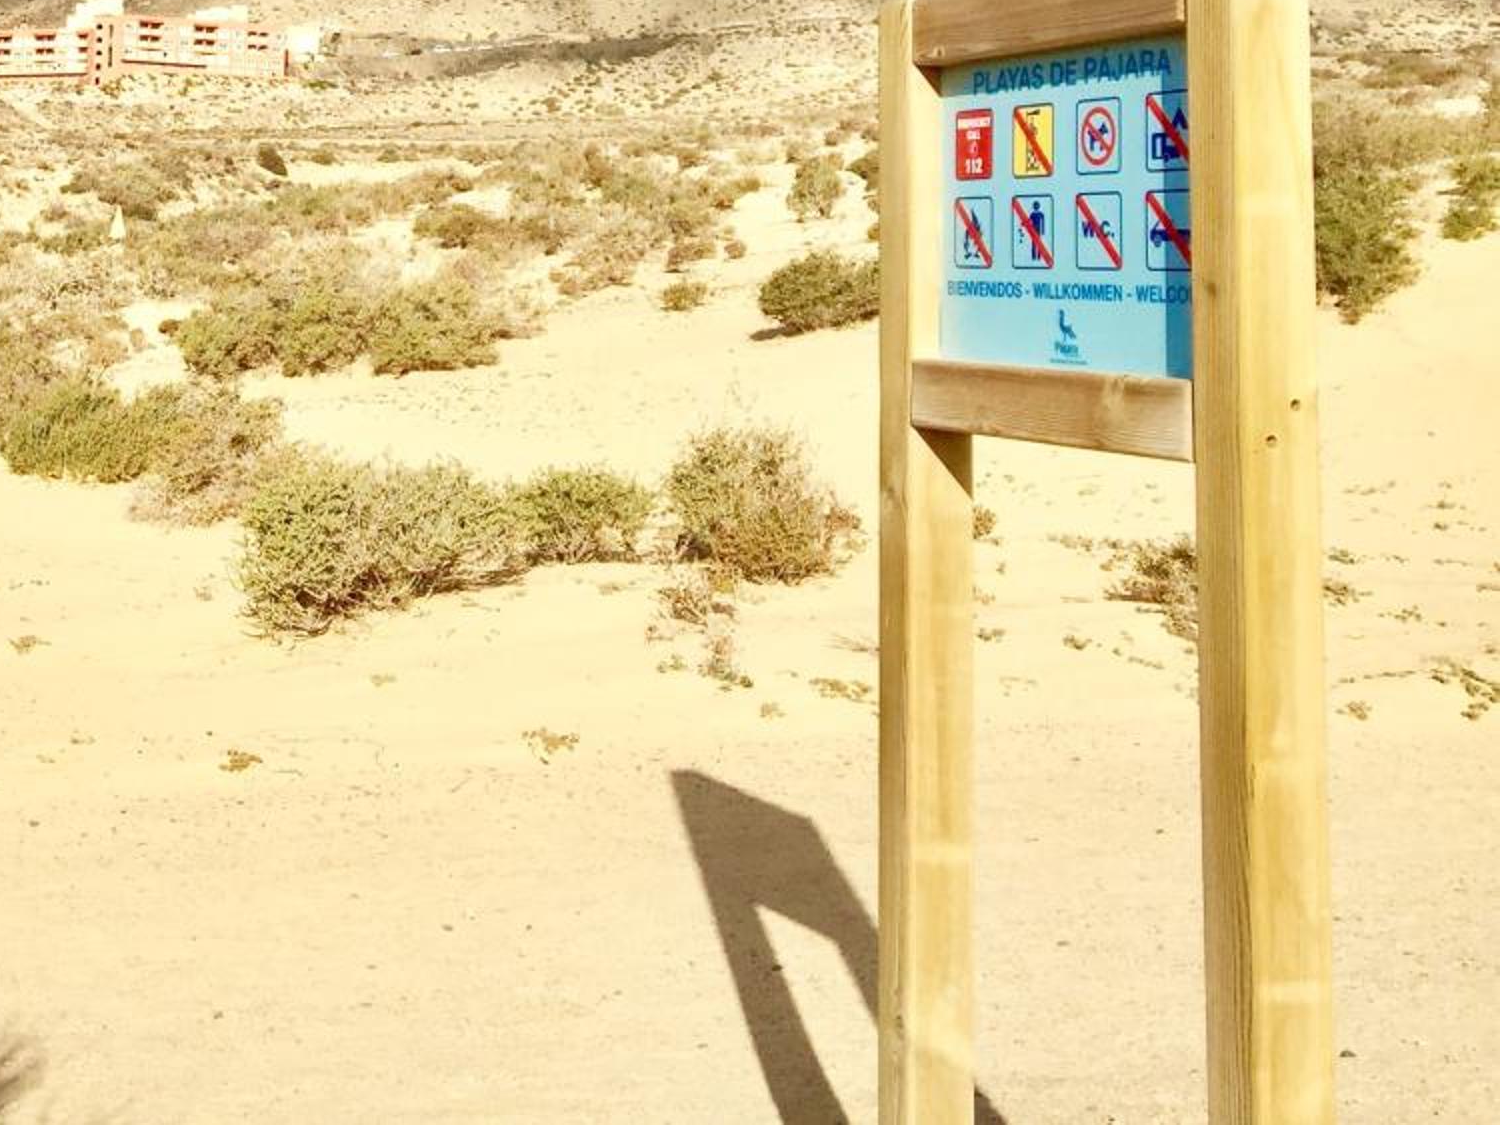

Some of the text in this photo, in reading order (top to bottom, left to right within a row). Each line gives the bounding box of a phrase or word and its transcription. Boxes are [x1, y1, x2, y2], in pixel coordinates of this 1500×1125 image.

[973, 65, 1044, 95] PLAYAS
[1050, 60, 1077, 85] DE
[965, 158, 984, 174] 112
[947, 280, 1023, 298] BIENVENIDOS
[1033, 282, 1123, 302] WILLKOMMEN
[1136, 285, 1192, 304] WELCO
